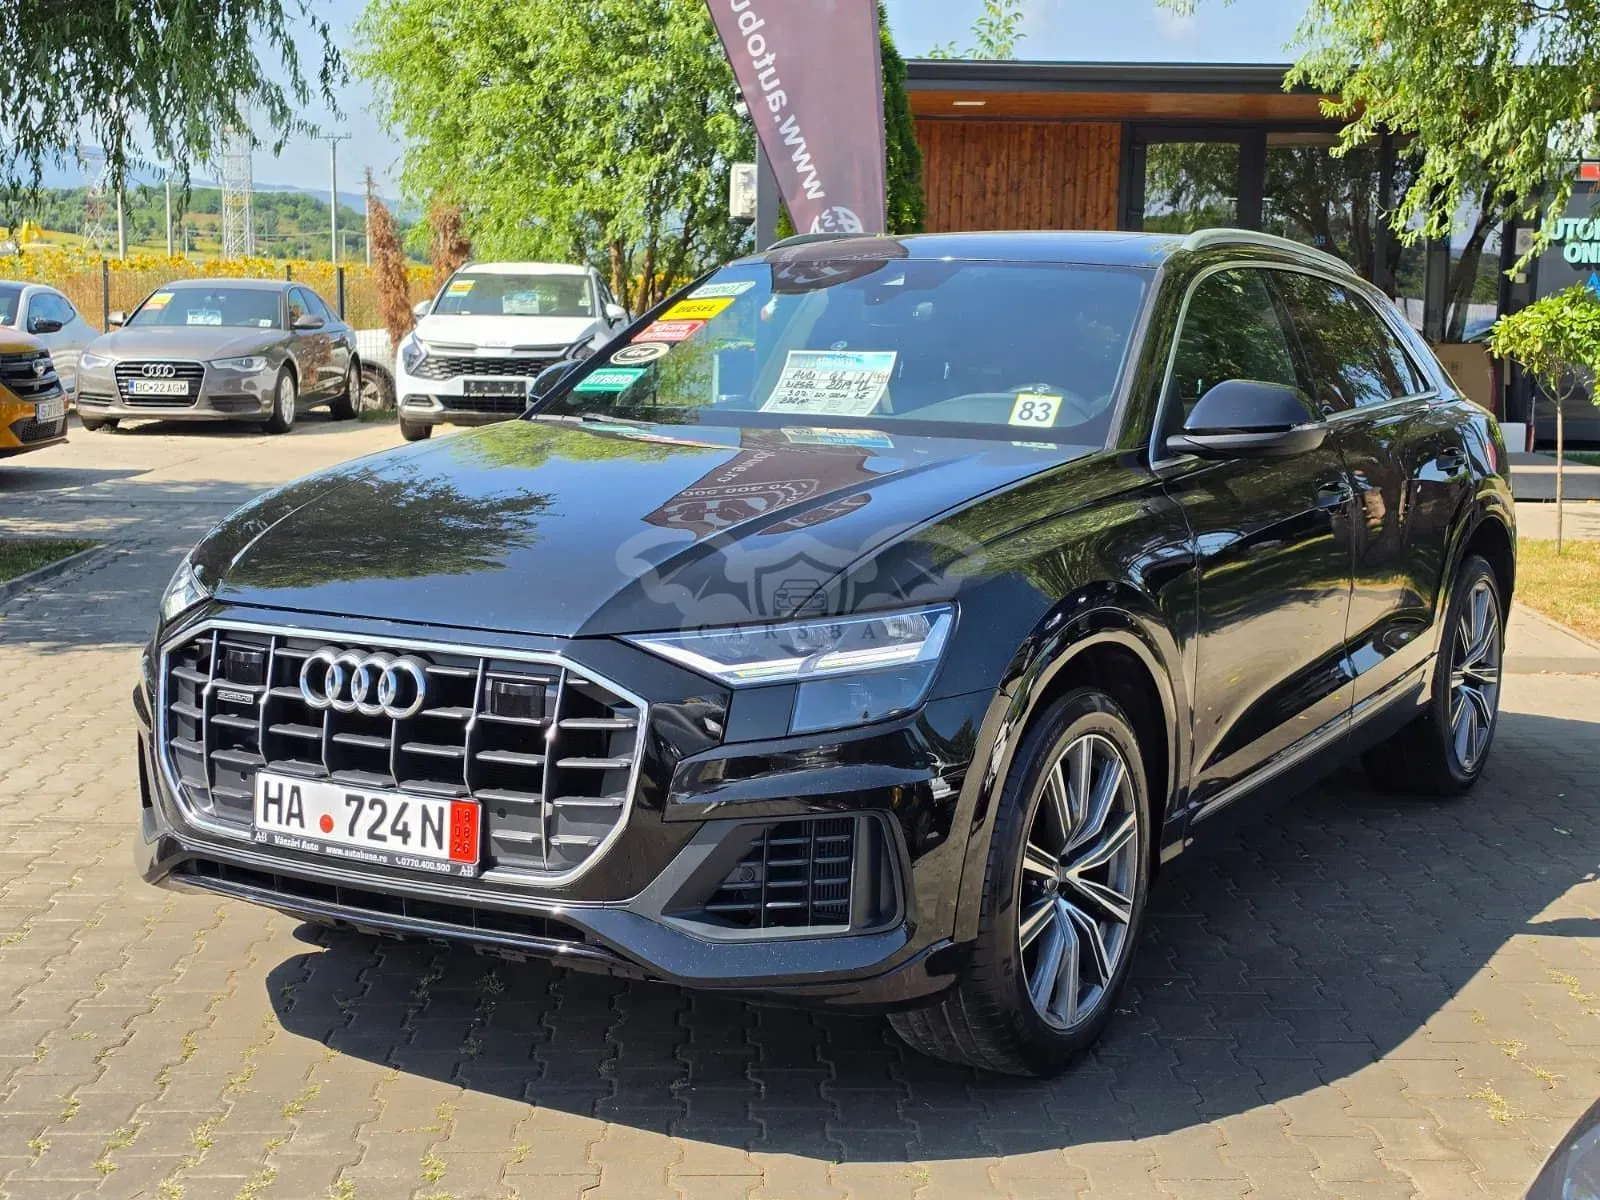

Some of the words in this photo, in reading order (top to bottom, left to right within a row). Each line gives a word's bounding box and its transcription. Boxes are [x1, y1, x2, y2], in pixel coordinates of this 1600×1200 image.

[673, 304, 716, 314] DIESEL
[586, 373, 633, 385] HYBRID
[1018, 401, 1052, 422] 83
[263, 780, 305, 829] HA
[456, 808, 471, 823] 18
[254, 832, 268, 842] AB
[455, 824, 470, 839] 08
[301, 841, 319, 851] Auto
[454, 839, 470, 854] 26
[326, 846, 388, 863] www.autobune.ro
[401, 858, 451, 872] 0770.400.500
[459, 866, 474, 877] AB
